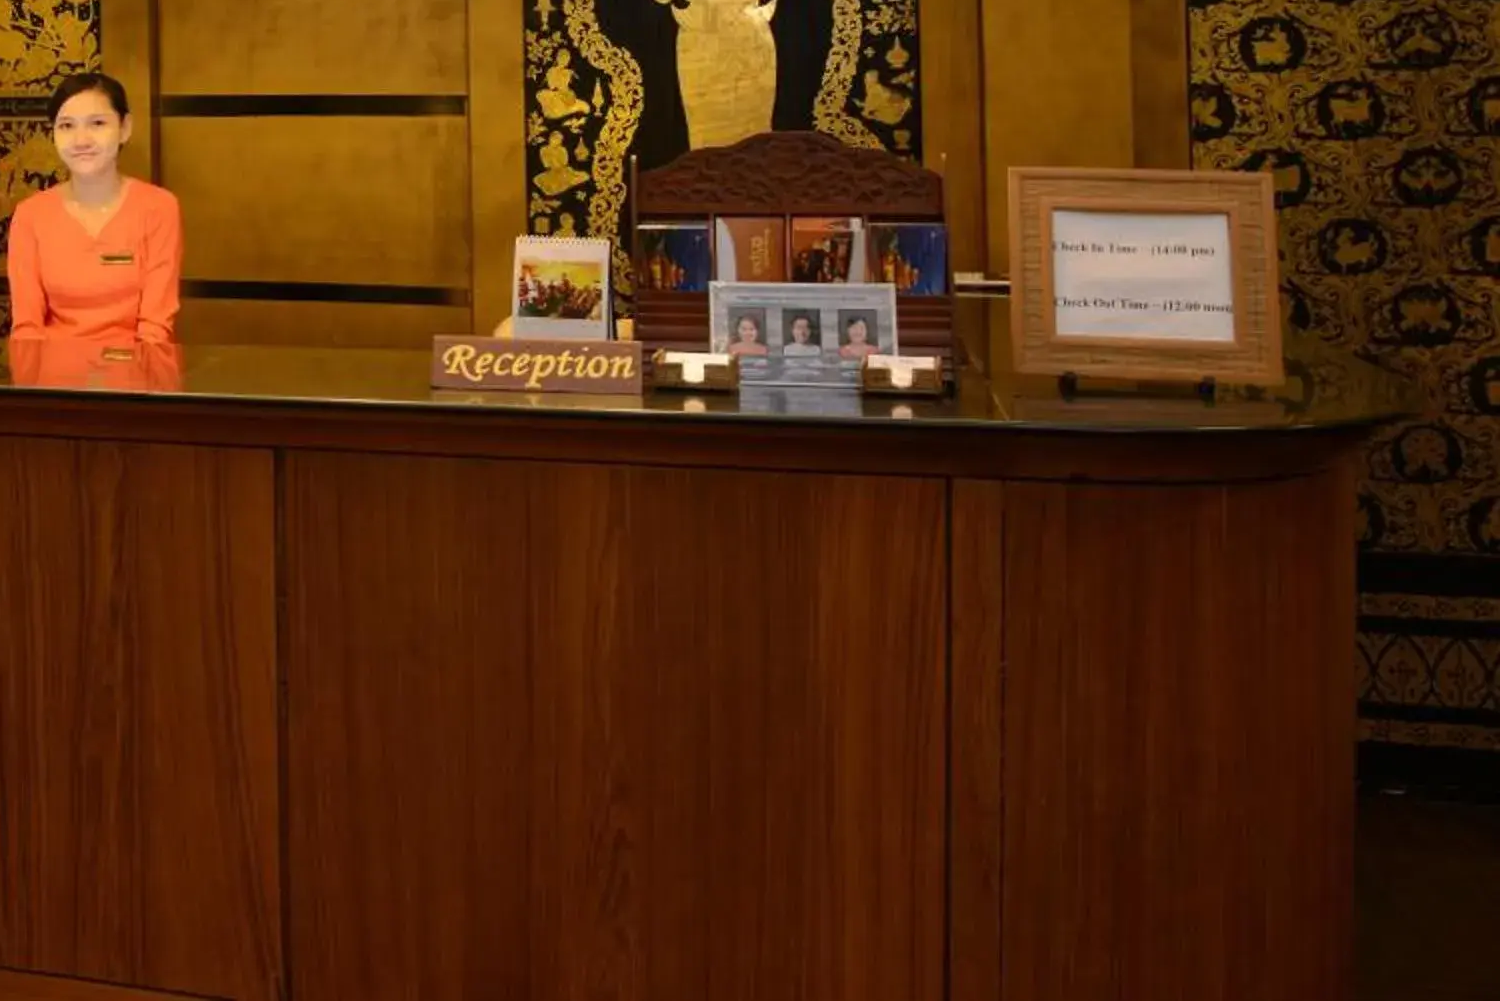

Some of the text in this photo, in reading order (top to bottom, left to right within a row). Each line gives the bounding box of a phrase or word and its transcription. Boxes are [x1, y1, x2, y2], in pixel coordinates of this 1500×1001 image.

[1108, 242, 1137, 254] Time
[1092, 297, 1116, 309] Out
[1119, 298, 1149, 310] Time
[441, 344, 635, 389] Reception
